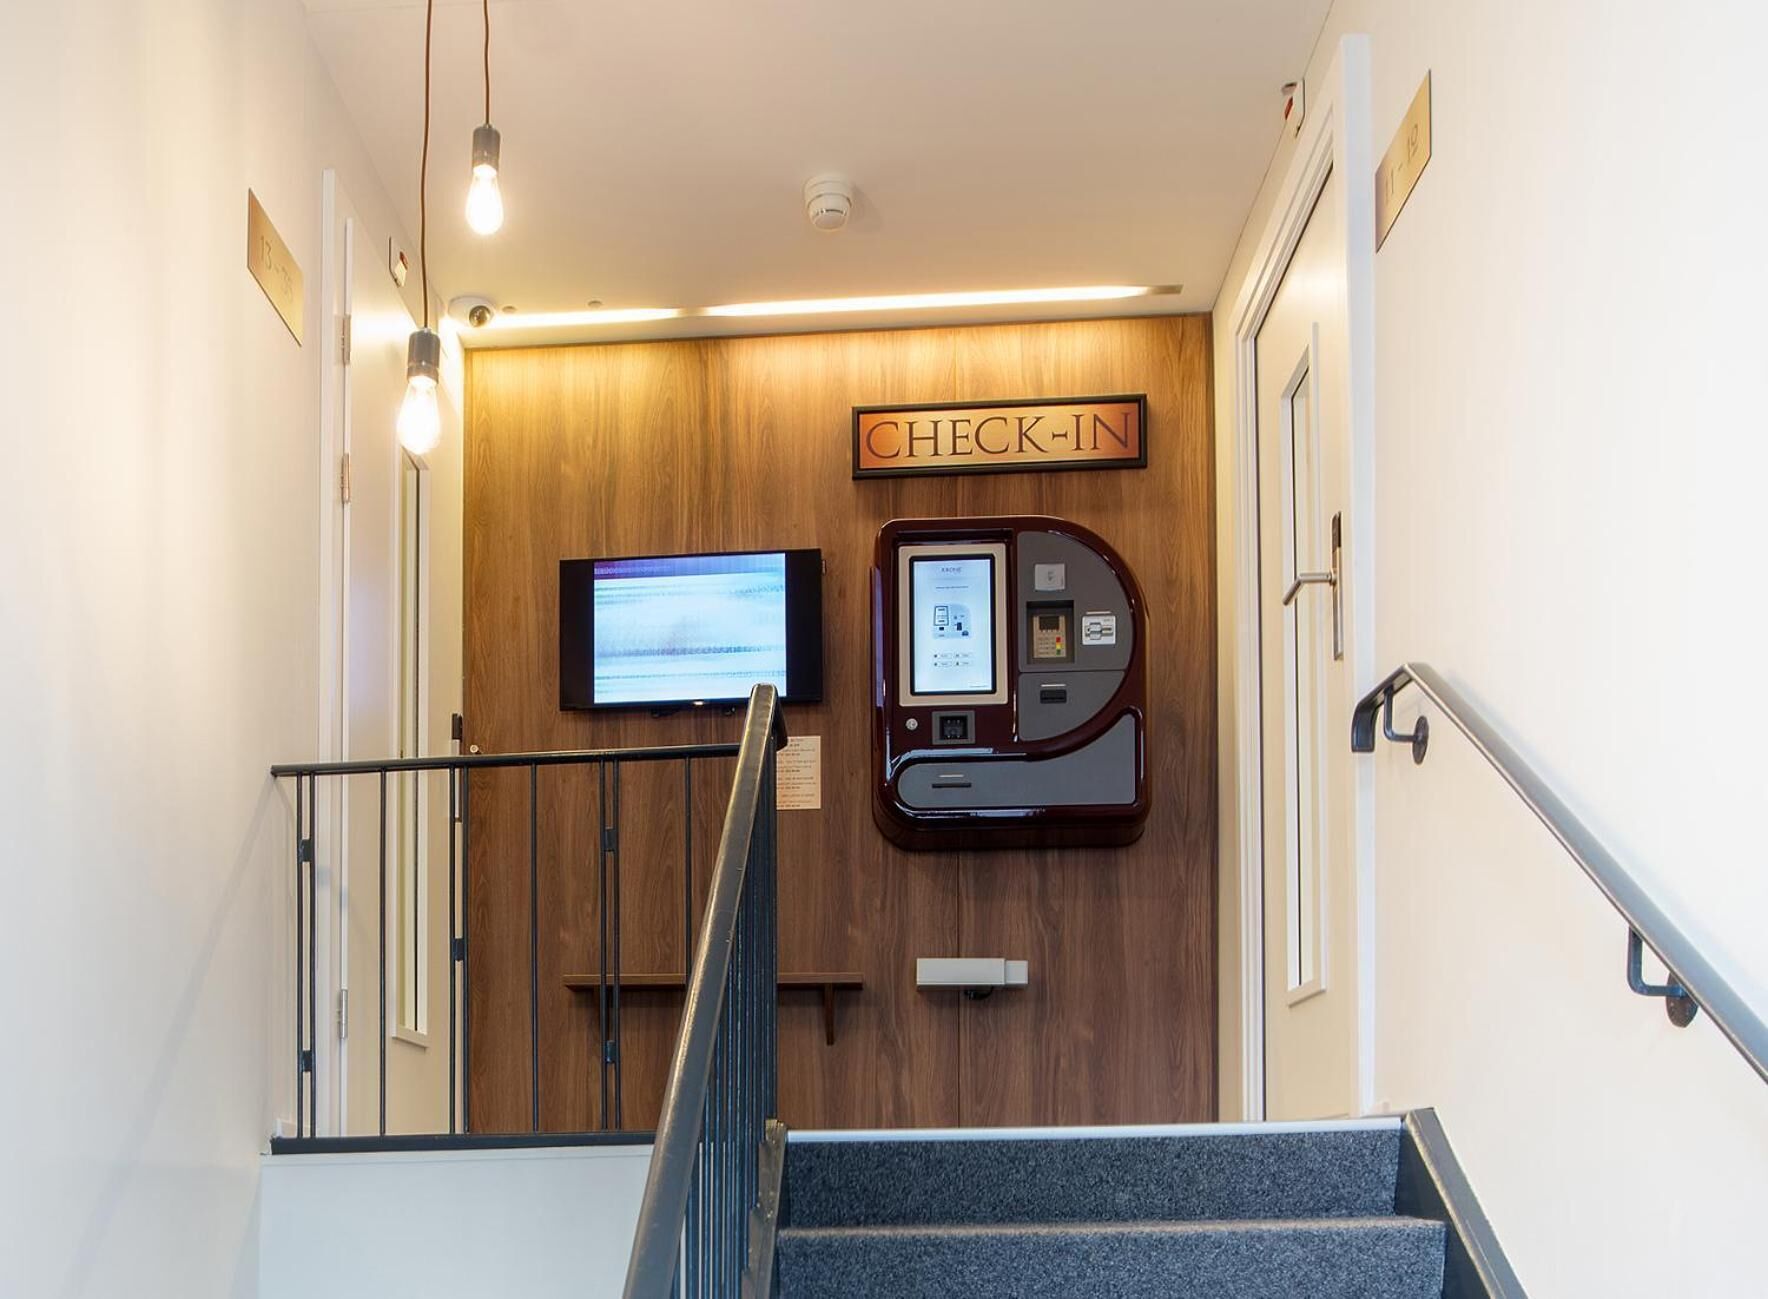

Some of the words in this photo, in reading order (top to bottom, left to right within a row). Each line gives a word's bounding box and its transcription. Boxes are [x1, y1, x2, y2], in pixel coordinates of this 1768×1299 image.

[1407, 123, 1419, 165] 19
[260, 234, 273, 271] 13
[865, 411, 1131, 460] CHECK-IN
